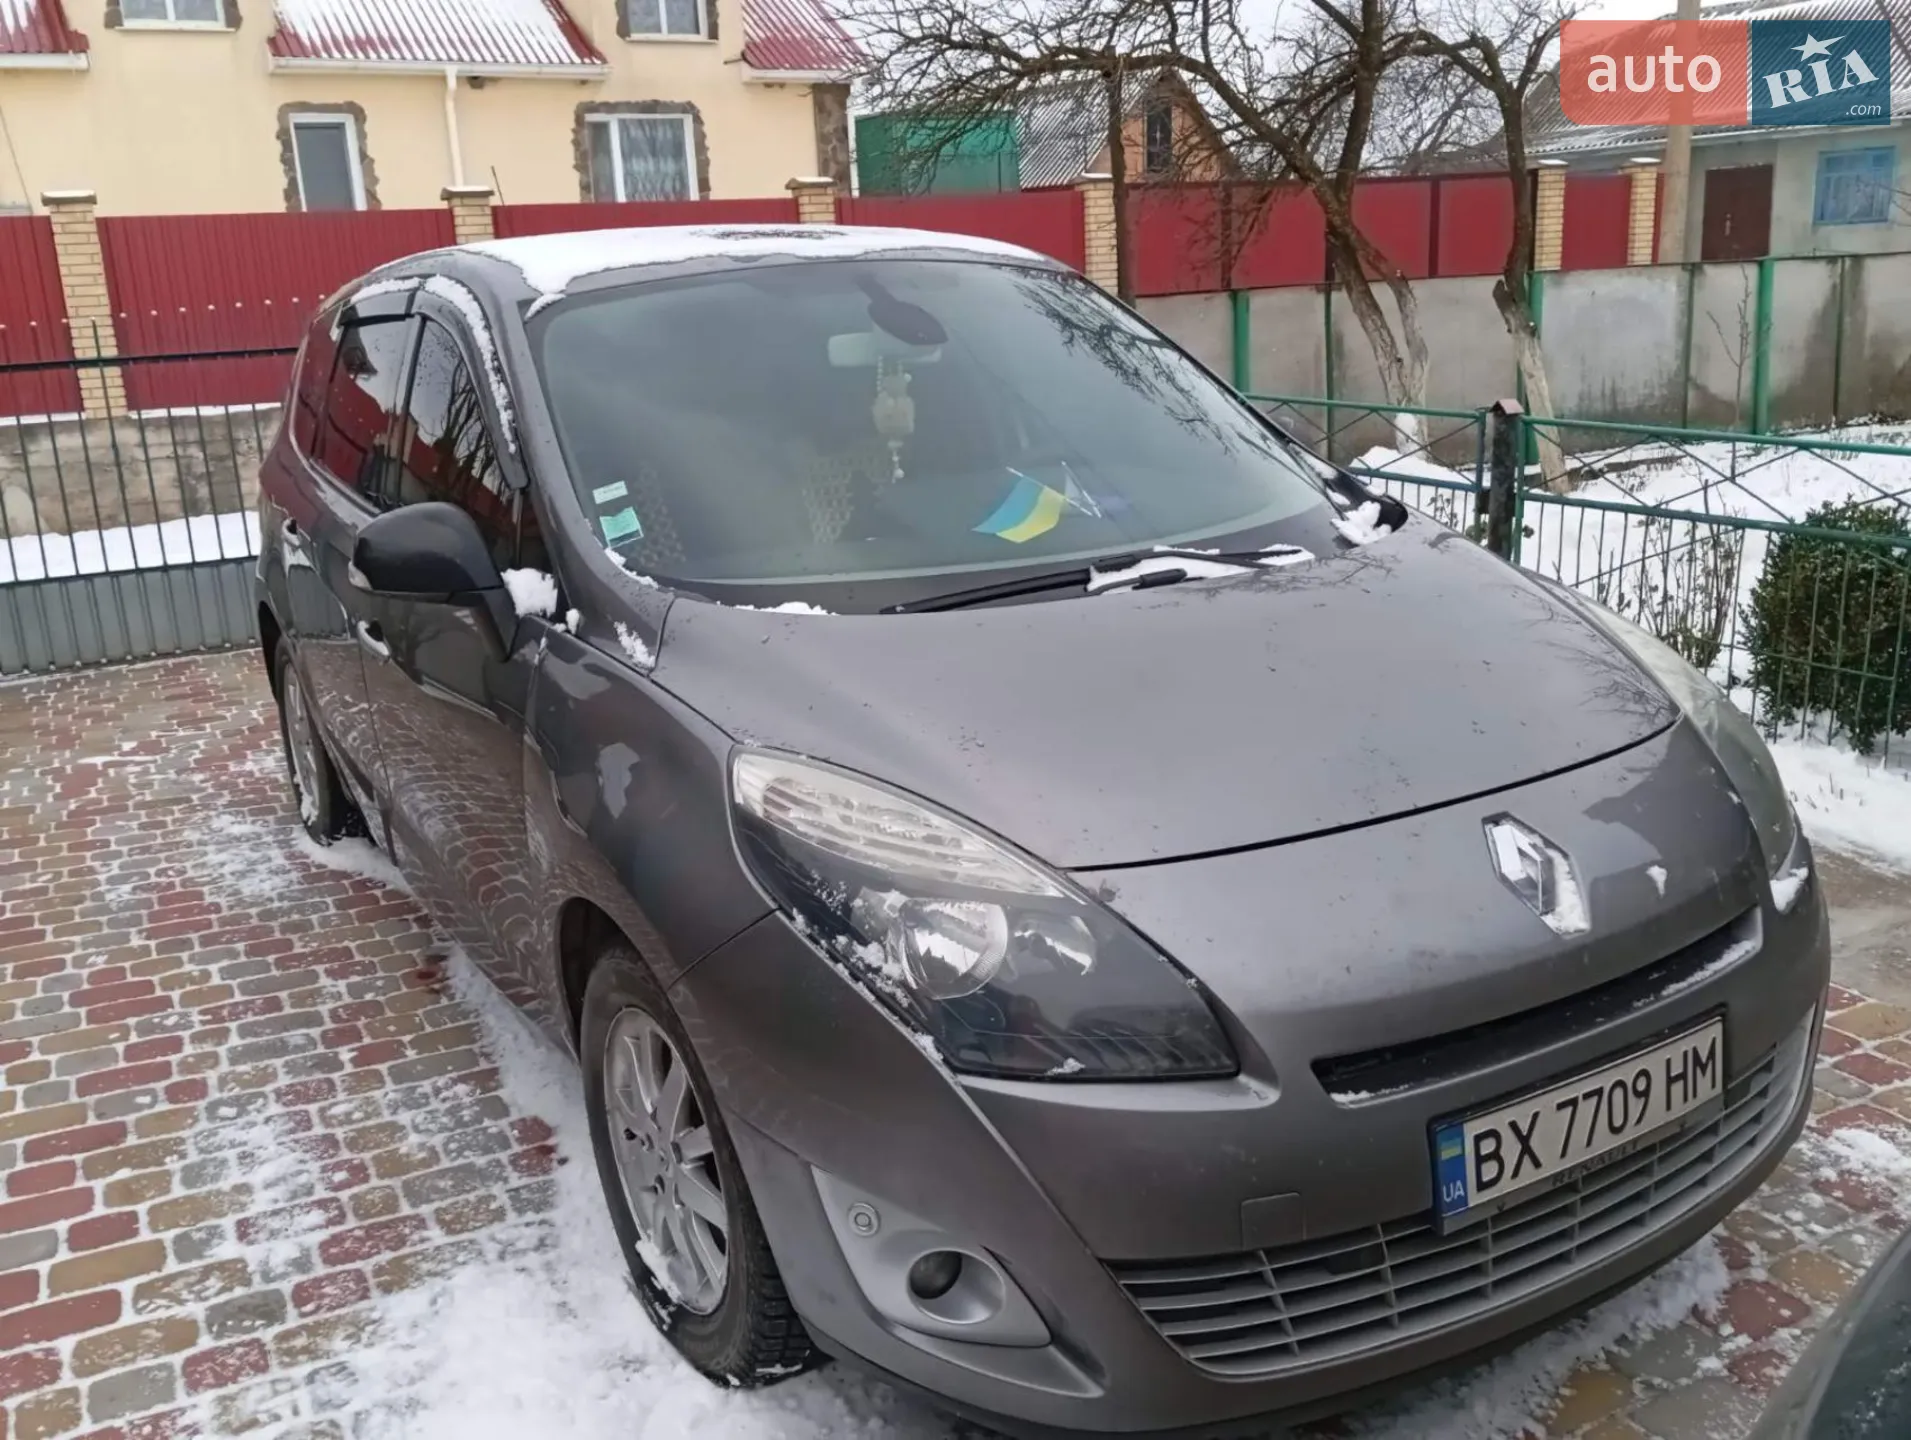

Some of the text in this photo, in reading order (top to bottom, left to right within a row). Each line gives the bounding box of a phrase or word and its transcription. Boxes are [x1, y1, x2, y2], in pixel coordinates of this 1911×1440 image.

[1473, 1036, 1718, 1193] BX 7709 HM
[1443, 1179, 1465, 1203] UA
